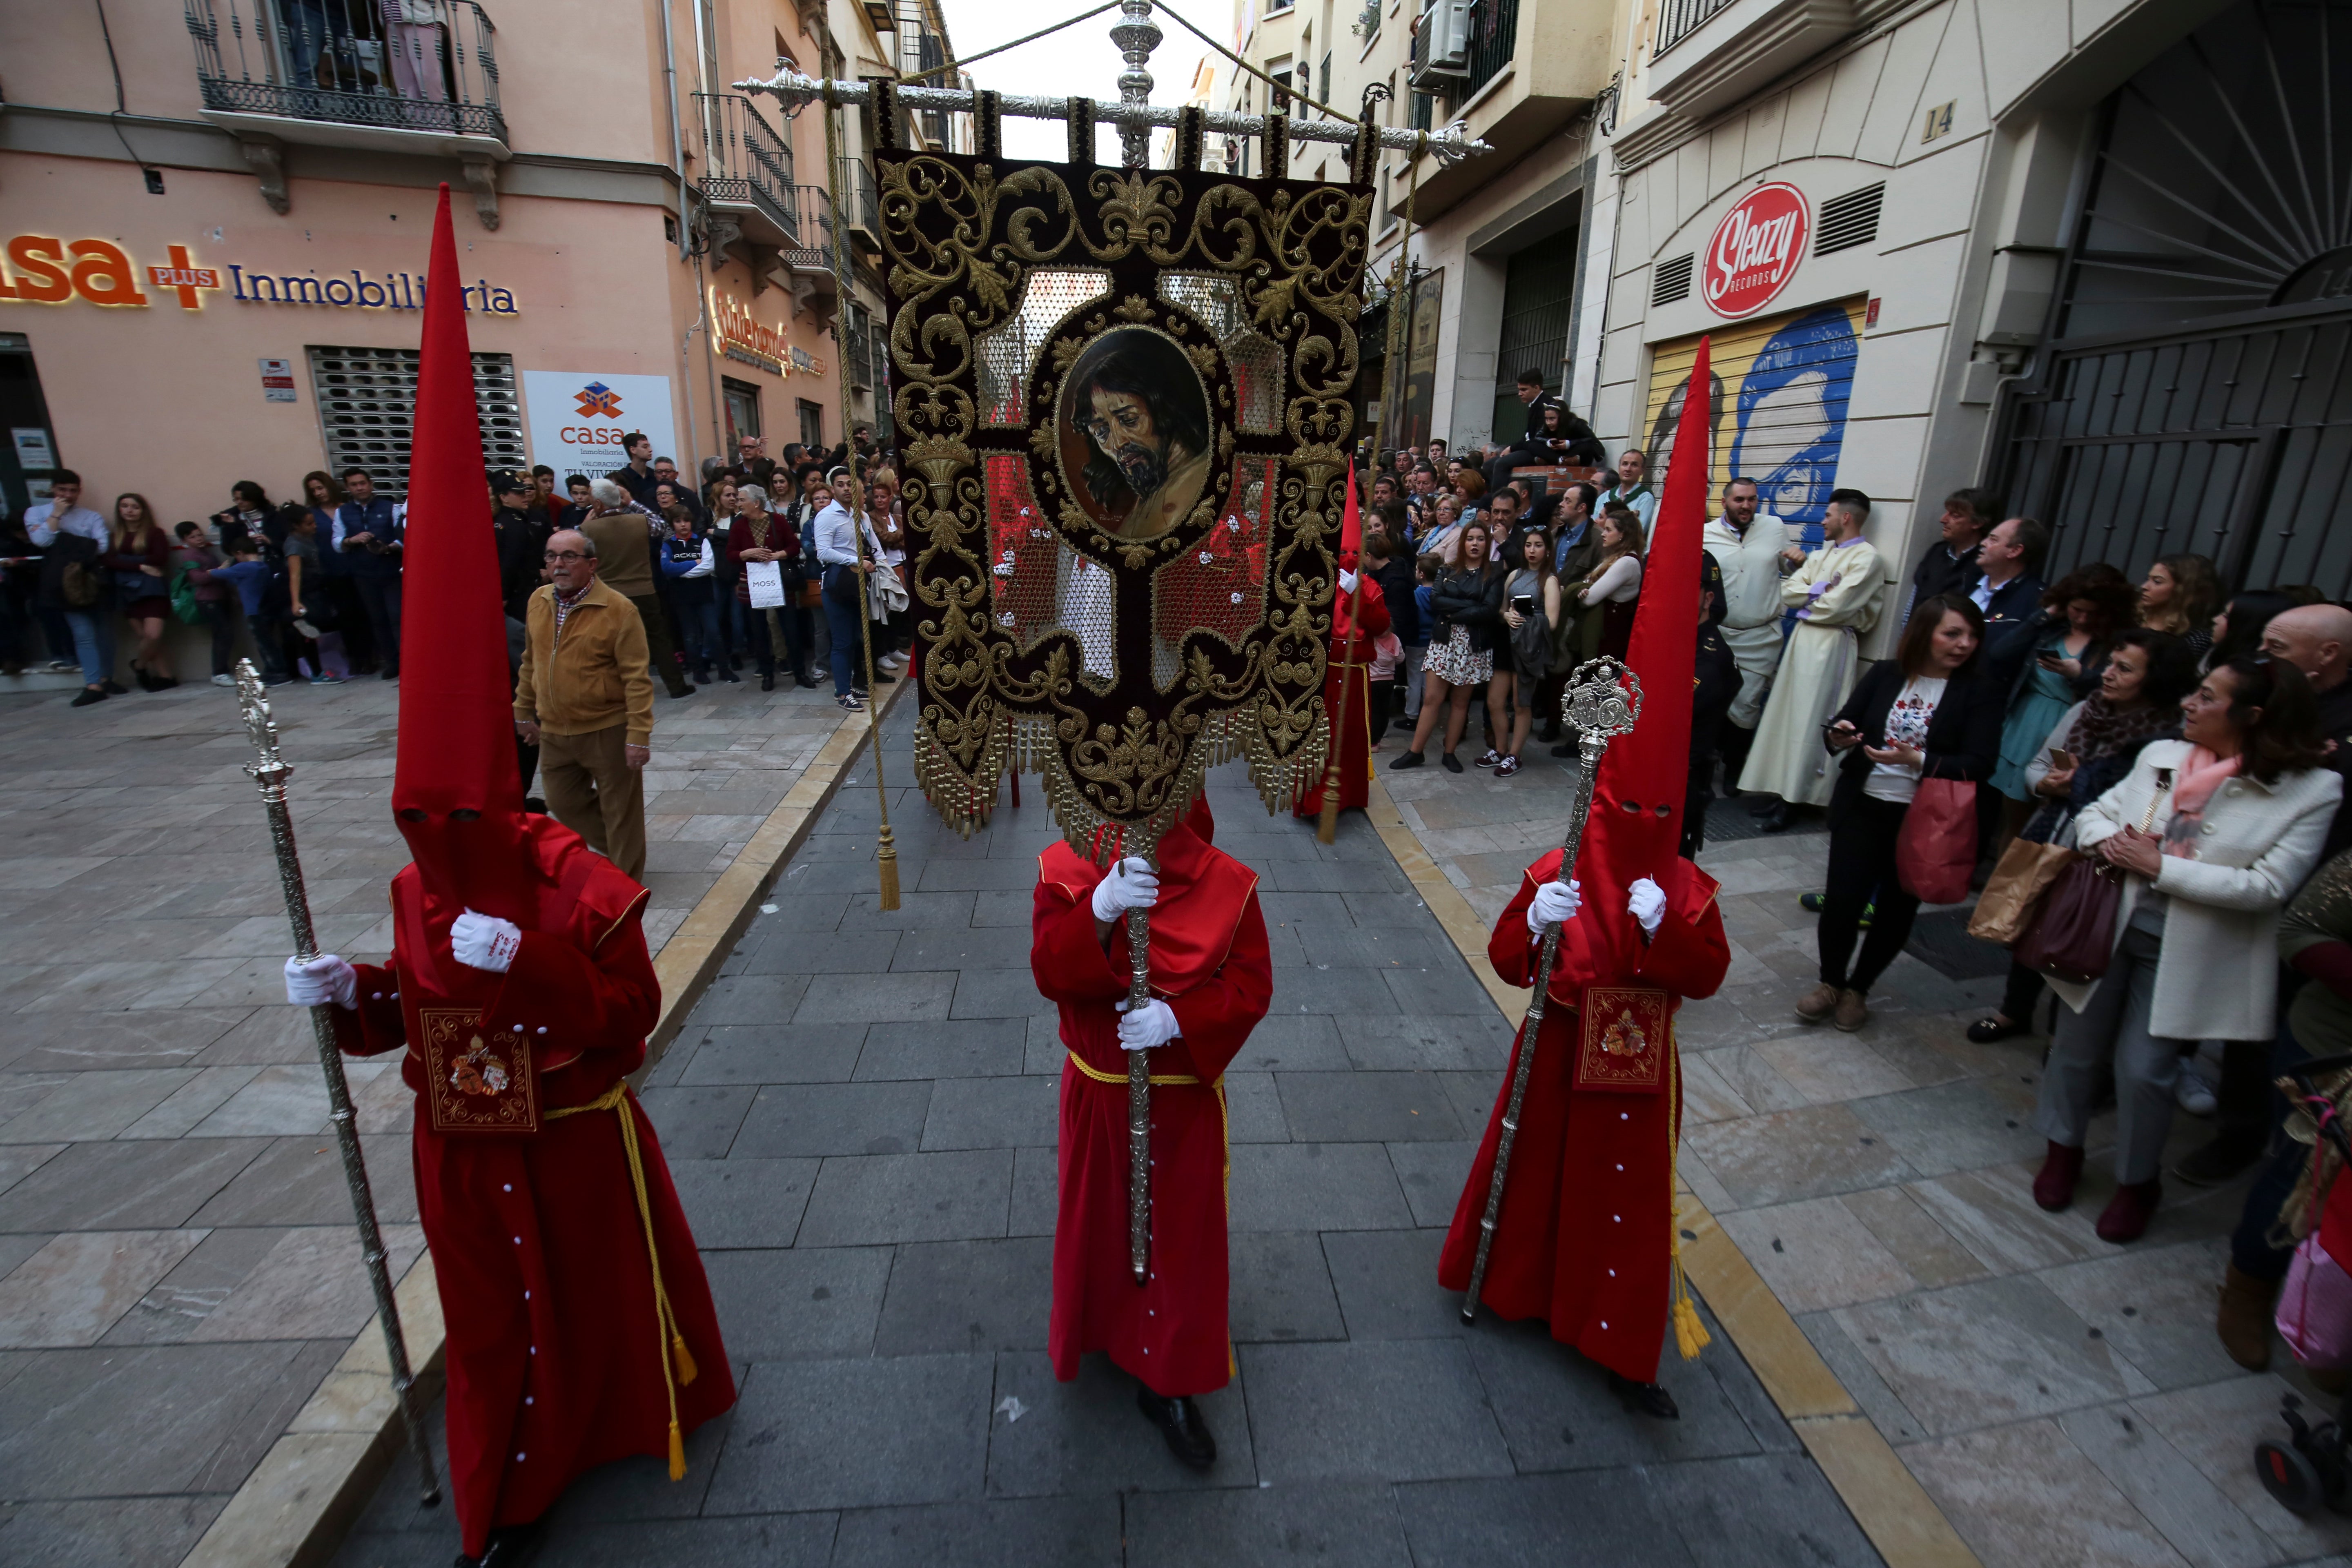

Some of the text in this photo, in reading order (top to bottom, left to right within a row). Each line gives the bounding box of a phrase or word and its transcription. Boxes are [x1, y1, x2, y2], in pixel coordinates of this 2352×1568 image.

[1925, 102, 1953, 139] 14
[1710, 205, 1798, 300] Sleazy
[155, 269, 212, 287] PLUS
[228, 265, 517, 314] Inmobiliria
[1730, 270, 1769, 293] RECORDS
[560, 427, 624, 445] casa
